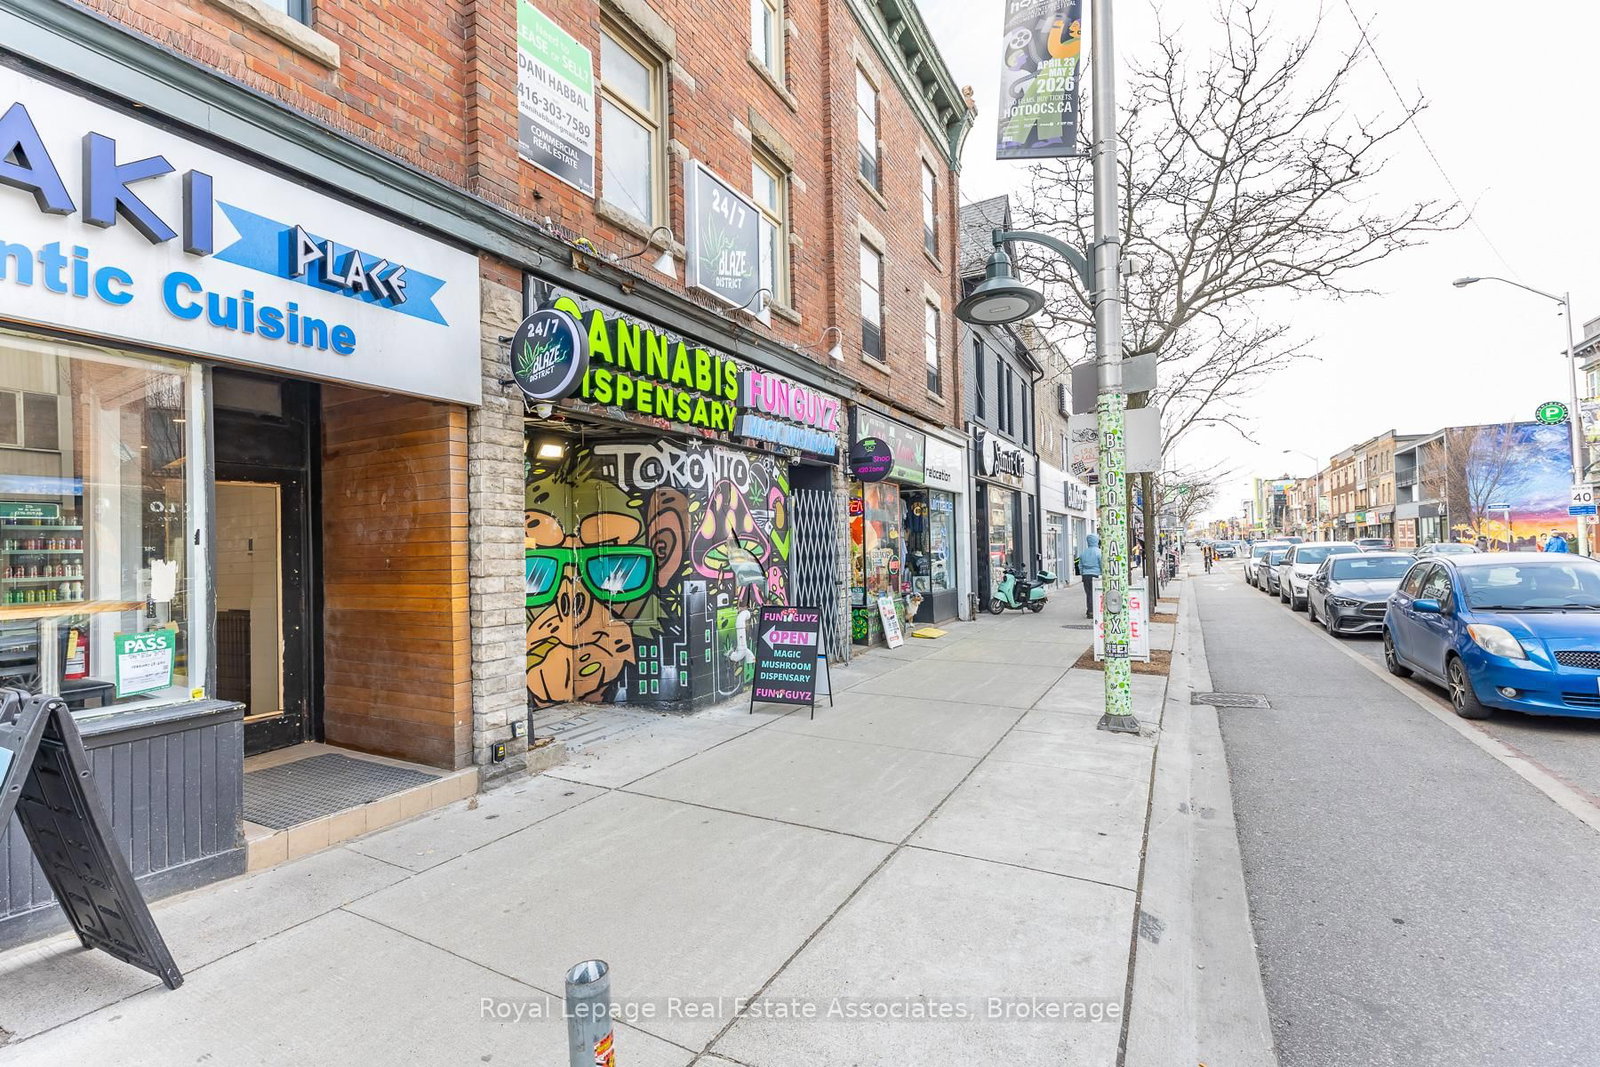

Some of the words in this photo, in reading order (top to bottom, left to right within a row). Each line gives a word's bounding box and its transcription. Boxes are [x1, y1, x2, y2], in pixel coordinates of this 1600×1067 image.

[1049, 67, 1067, 77] MAY
[1068, 66, 1075, 77] 3
[518, 53, 546, 83] DANI
[548, 74, 589, 112] HABBAL
[1036, 76, 1075, 93] 2026
[517, 82, 591, 138] 416-303-7589
[1003, 102, 1073, 118] HOTDOCS.CA
[530, 125, 580, 161] COMMERCIAL
[532, 137, 553, 155] REAL
[553, 148, 578, 169] ESTATE
[711, 189, 746, 228] 24/7
[290, 225, 408, 305] PLACE
[718, 245, 748, 277] BLAZE
[715, 276, 742, 290] DISTRICT
[163, 272, 357, 355] Cuisine
[527, 318, 560, 338] 24/7
[529, 365, 555, 383] DISTRICT
[582, 366, 738, 432] ISPENSARY
[749, 370, 790, 418] FUN
[793, 388, 838, 432] GUYZ
[594, 438, 750, 494] TORONTO
[925, 466, 952, 482] relocation
[1105, 432, 1117, 525] BLOOR
[1573, 492, 1592, 503] 40
[1108, 541, 1121, 635] ANNX
[764, 612, 783, 621] FUN
[792, 614, 818, 622] GUYZ
[124, 637, 167, 653] PASS
[769, 631, 809, 645] OPEN
[773, 650, 801, 658] MAGIC
[761, 661, 811, 671] MUSHROOM
[760, 672, 811, 683] DISPENSARY
[756, 688, 776, 698] FUN
[785, 690, 812, 700] GUYZ
